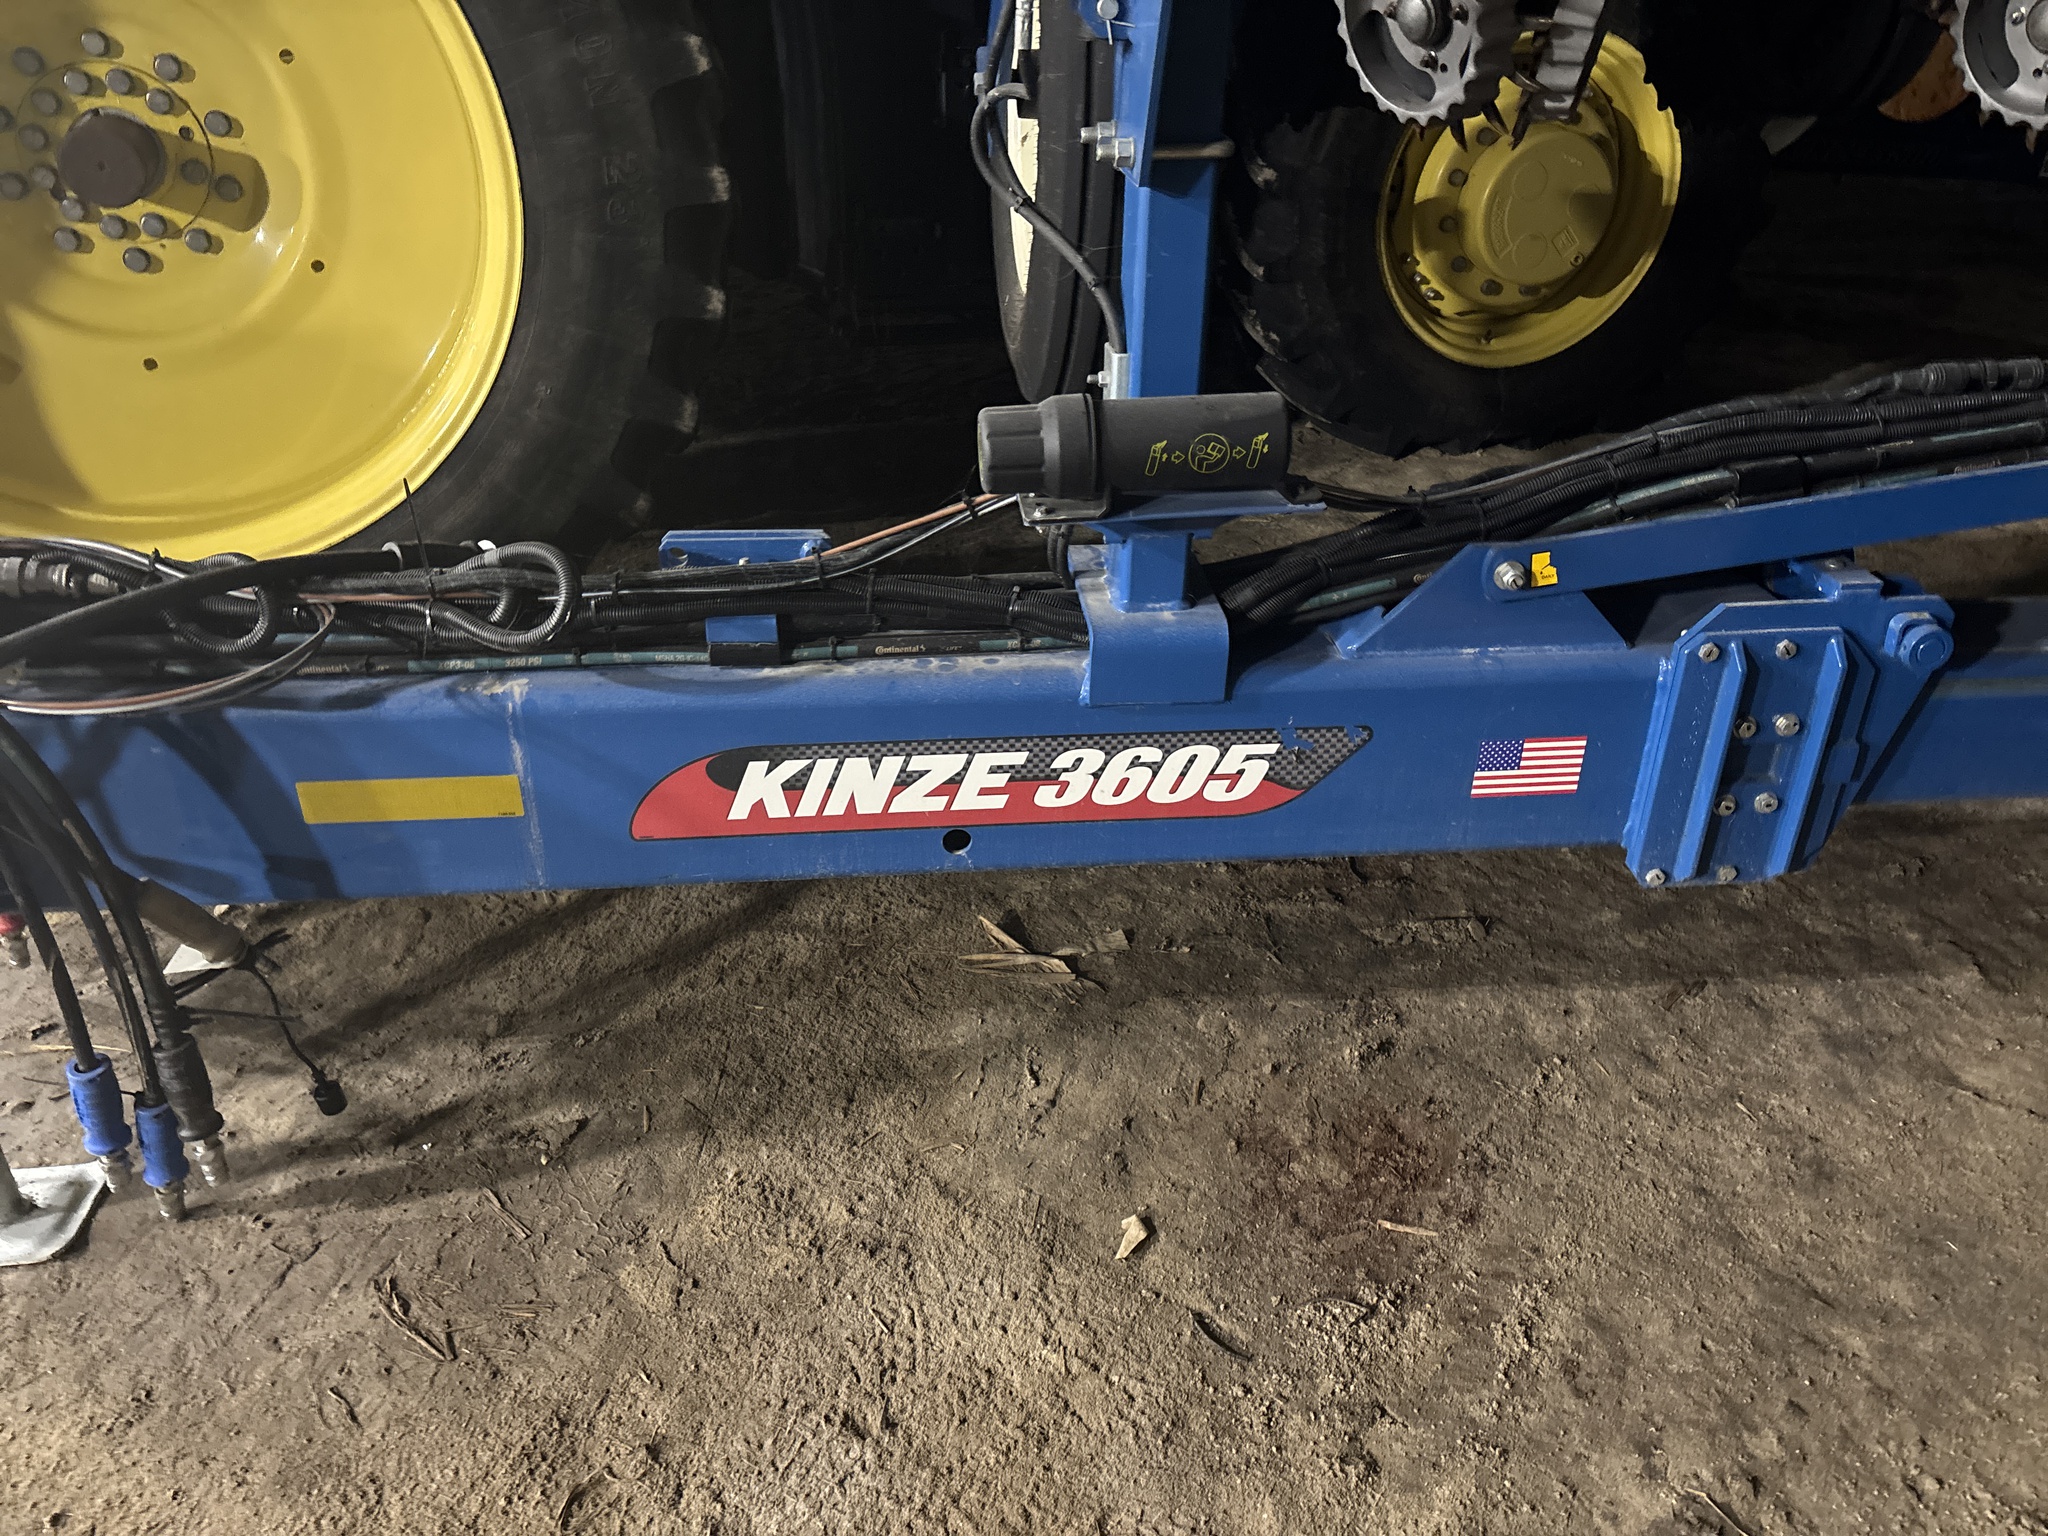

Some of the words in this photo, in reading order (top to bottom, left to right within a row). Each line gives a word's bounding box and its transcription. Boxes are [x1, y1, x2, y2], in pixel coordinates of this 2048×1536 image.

[875, 645, 919, 656] Continental
[297, 664, 343, 675] ontinental
[727, 750, 1029, 820] KINZE
[1033, 742, 1281, 808] 3605
